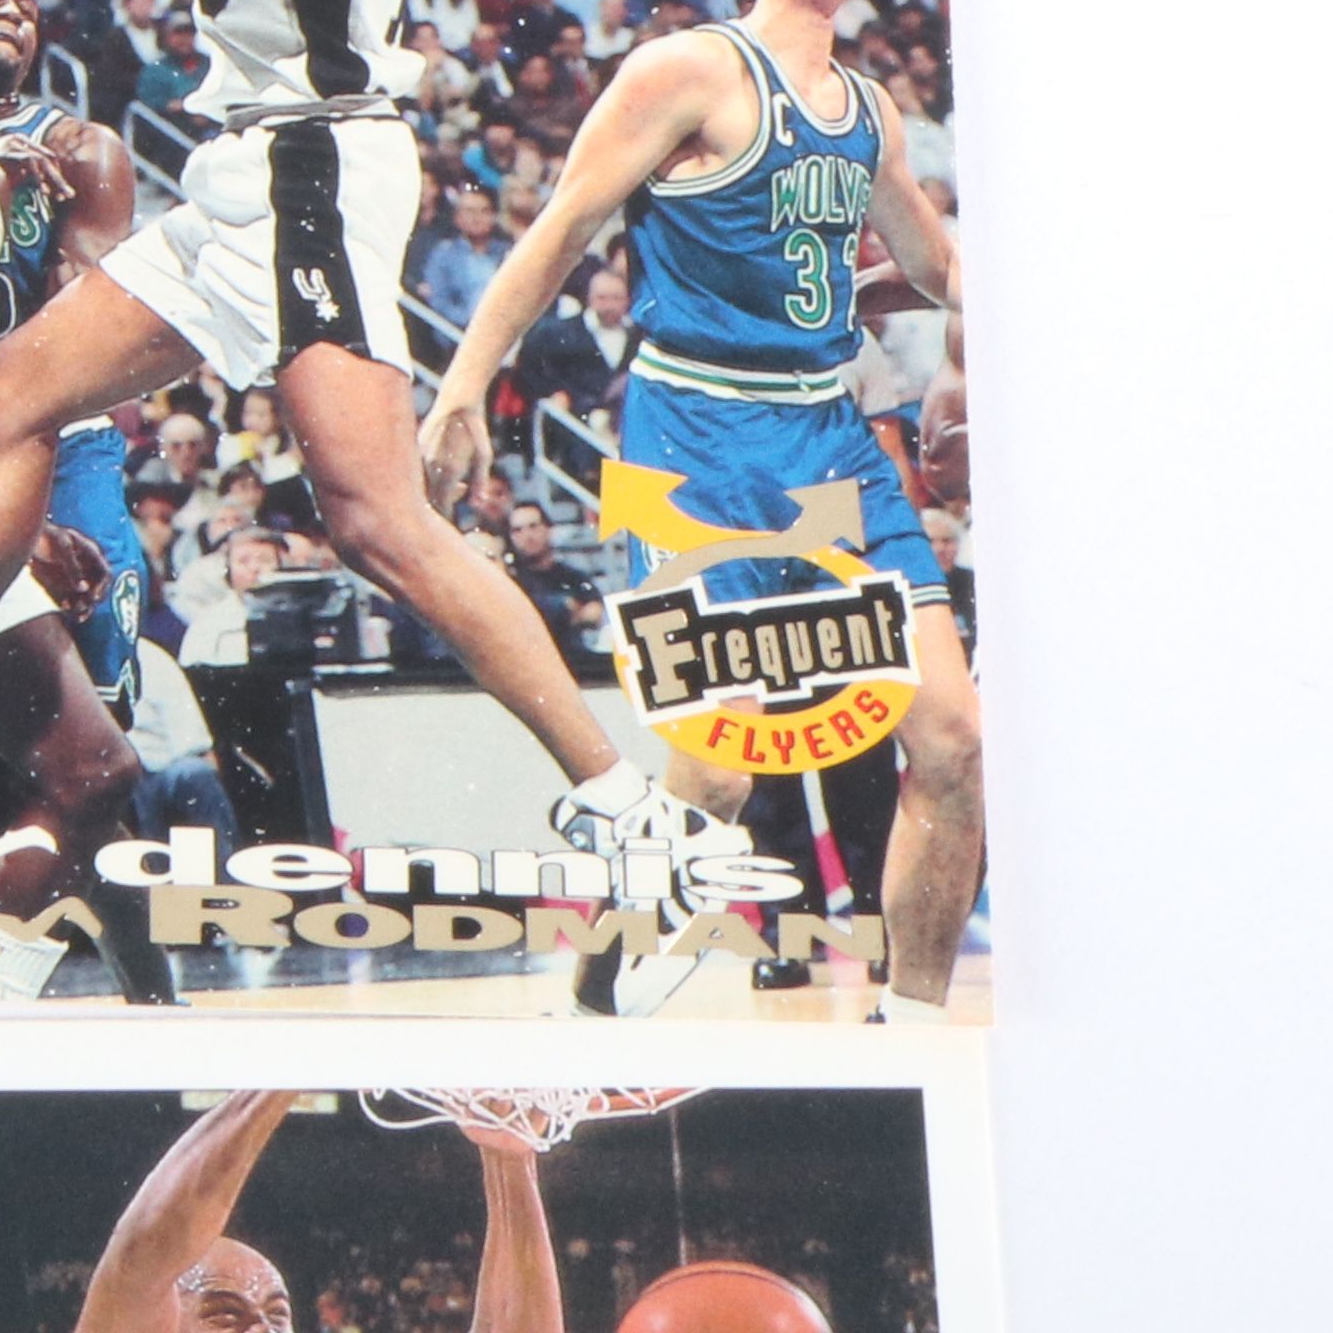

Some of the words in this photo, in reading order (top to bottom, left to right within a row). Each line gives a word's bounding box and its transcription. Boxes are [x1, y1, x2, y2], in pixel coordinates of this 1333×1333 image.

[632, 599, 895, 705] Frequent
[706, 689, 891, 766] FLYERS
[94, 826, 805, 903] dennis
[148, 884, 886, 962] RODMAN
